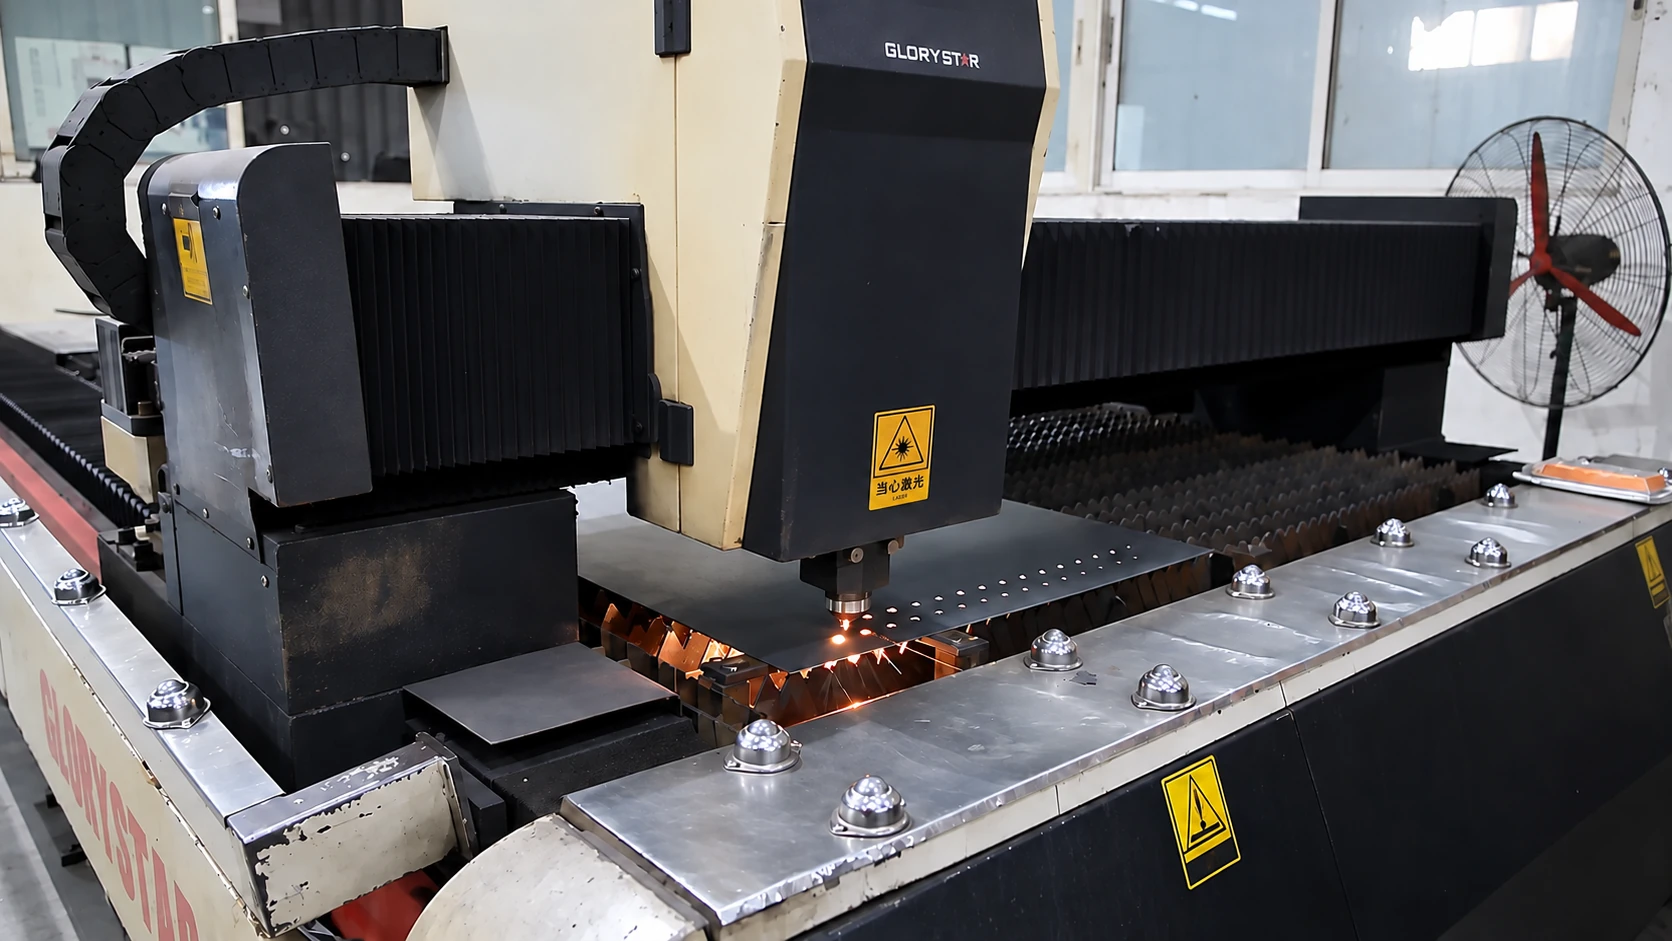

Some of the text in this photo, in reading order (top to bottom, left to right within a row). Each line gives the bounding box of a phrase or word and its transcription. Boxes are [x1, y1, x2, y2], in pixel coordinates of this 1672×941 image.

[884, 42, 980, 69] GLORYSTAR
[876, 474, 924, 496] 当心激光
